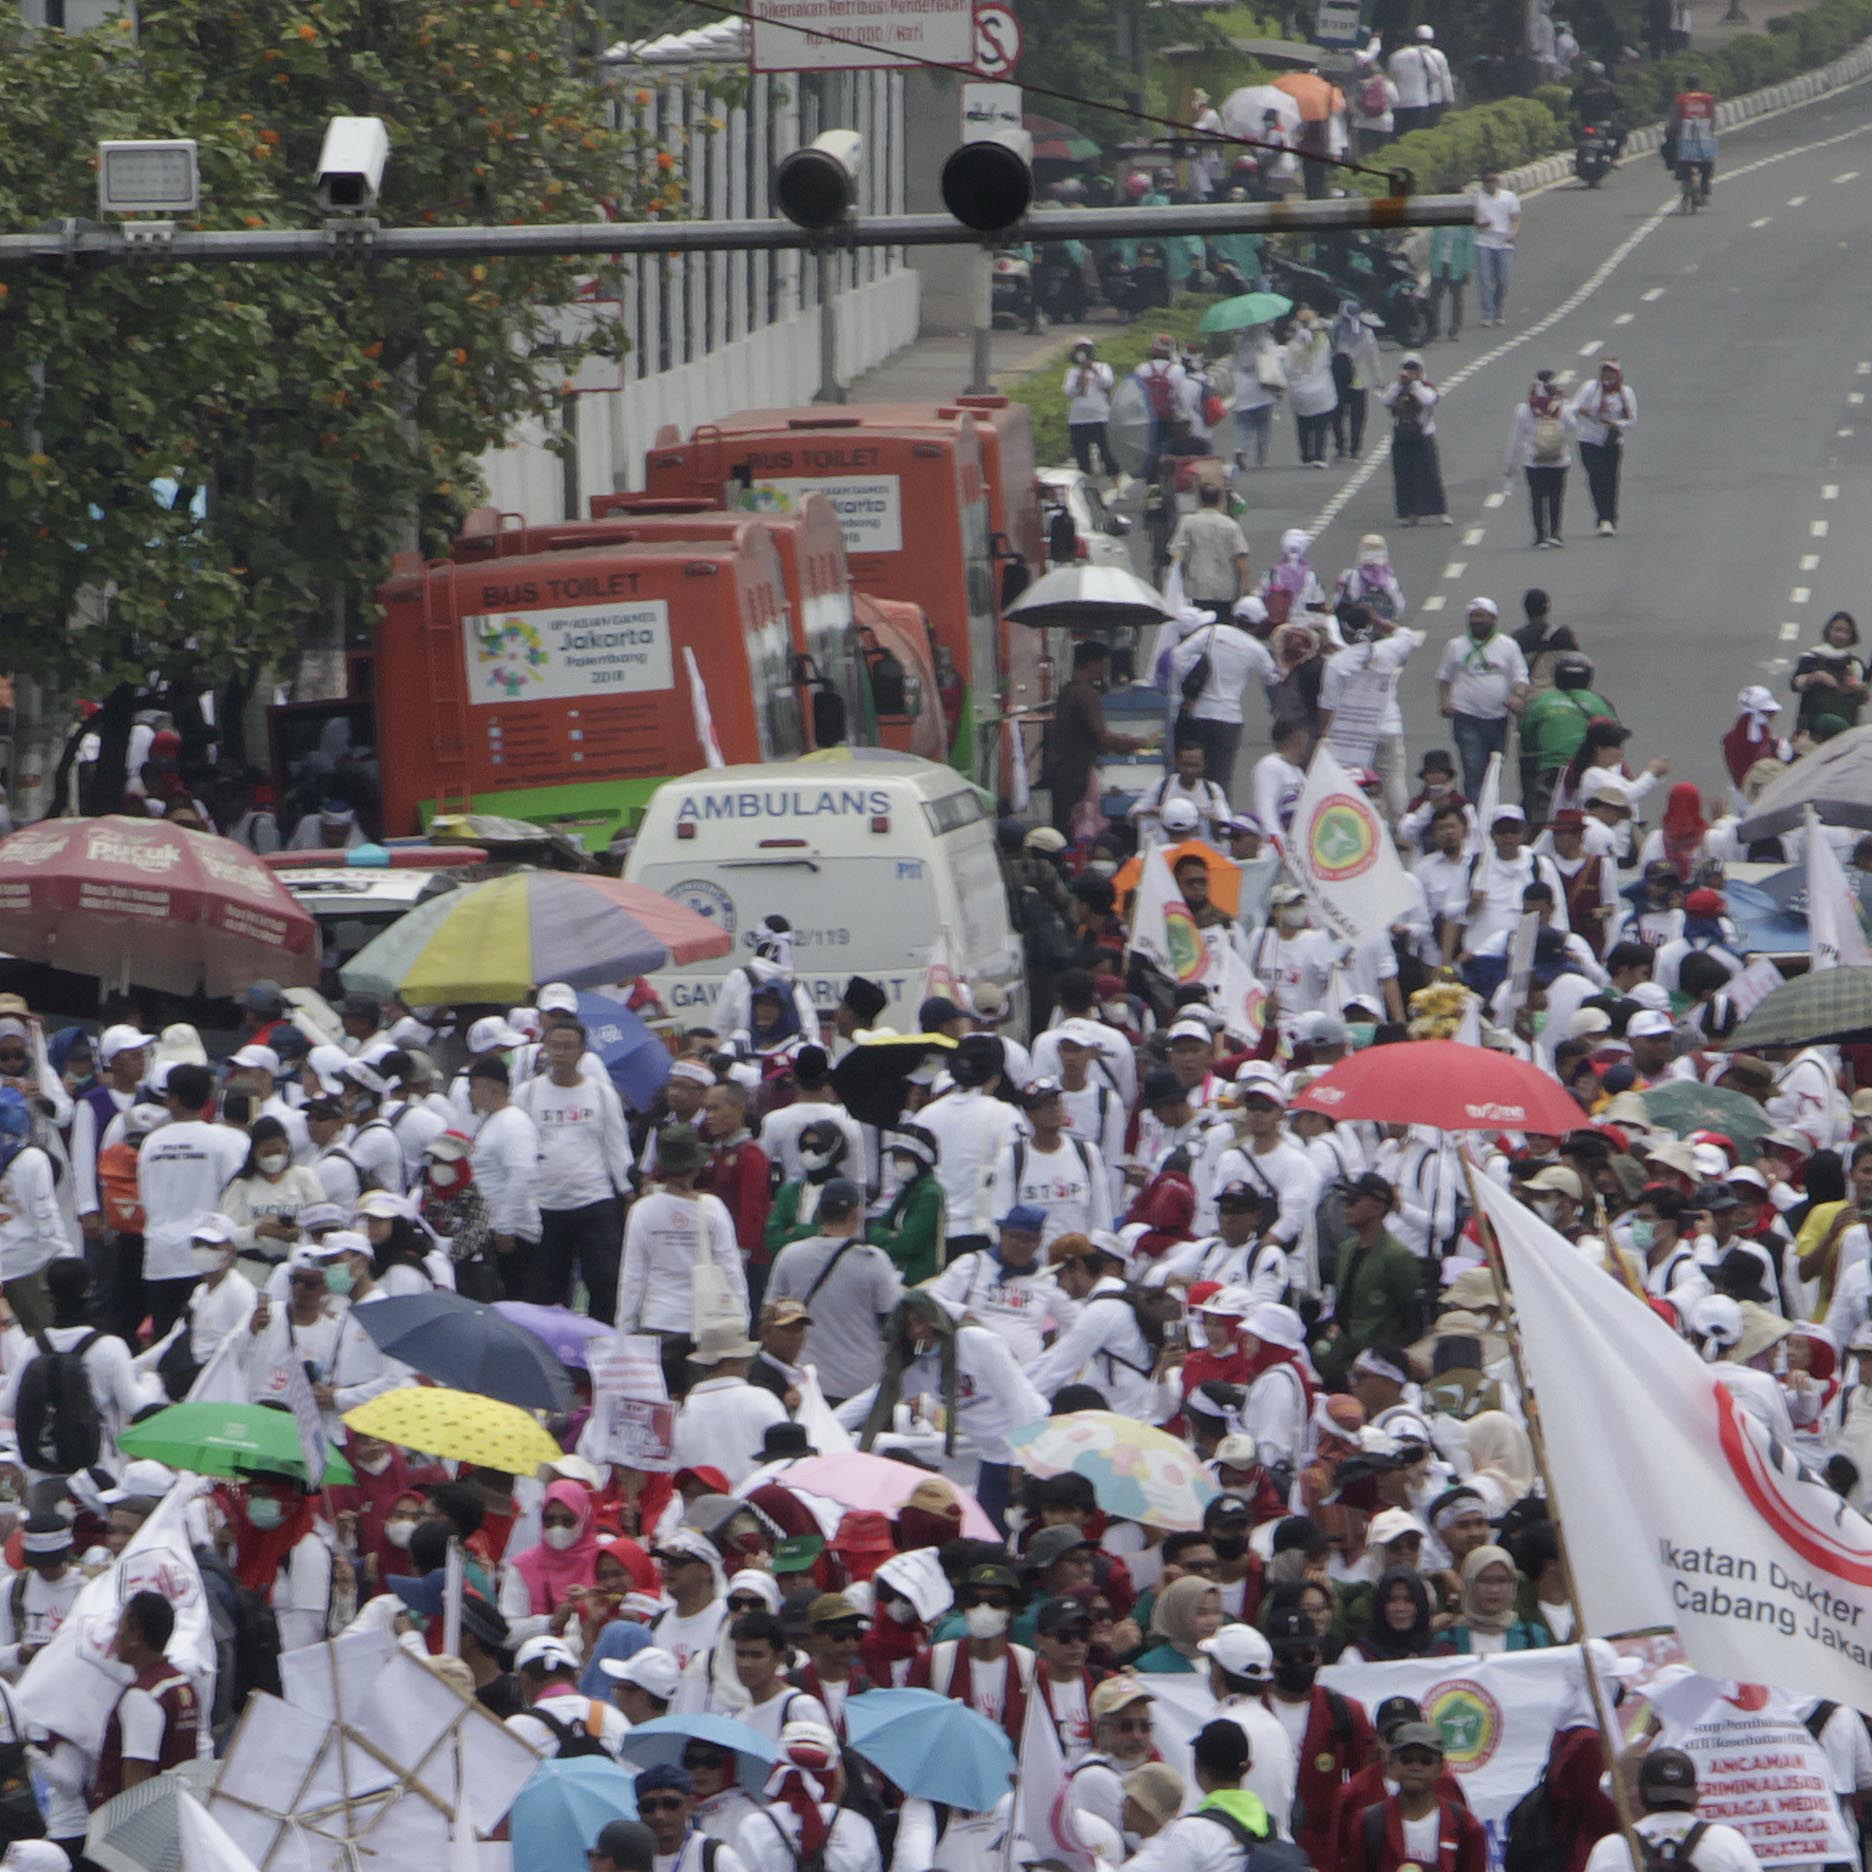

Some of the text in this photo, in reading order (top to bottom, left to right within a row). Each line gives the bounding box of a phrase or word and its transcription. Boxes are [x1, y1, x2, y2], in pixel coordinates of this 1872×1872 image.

[482, 573, 640, 606] BUS TOILET
[558, 626, 655, 652] Jakarta
[677, 790, 893, 821] AMBULANS
[1659, 1537, 1758, 1581] Ikatan
[1769, 1563, 1865, 1629] Dokter
[1671, 1580, 1799, 1638] Cabang
[1710, 1753, 1807, 1775] ANCAMAN
